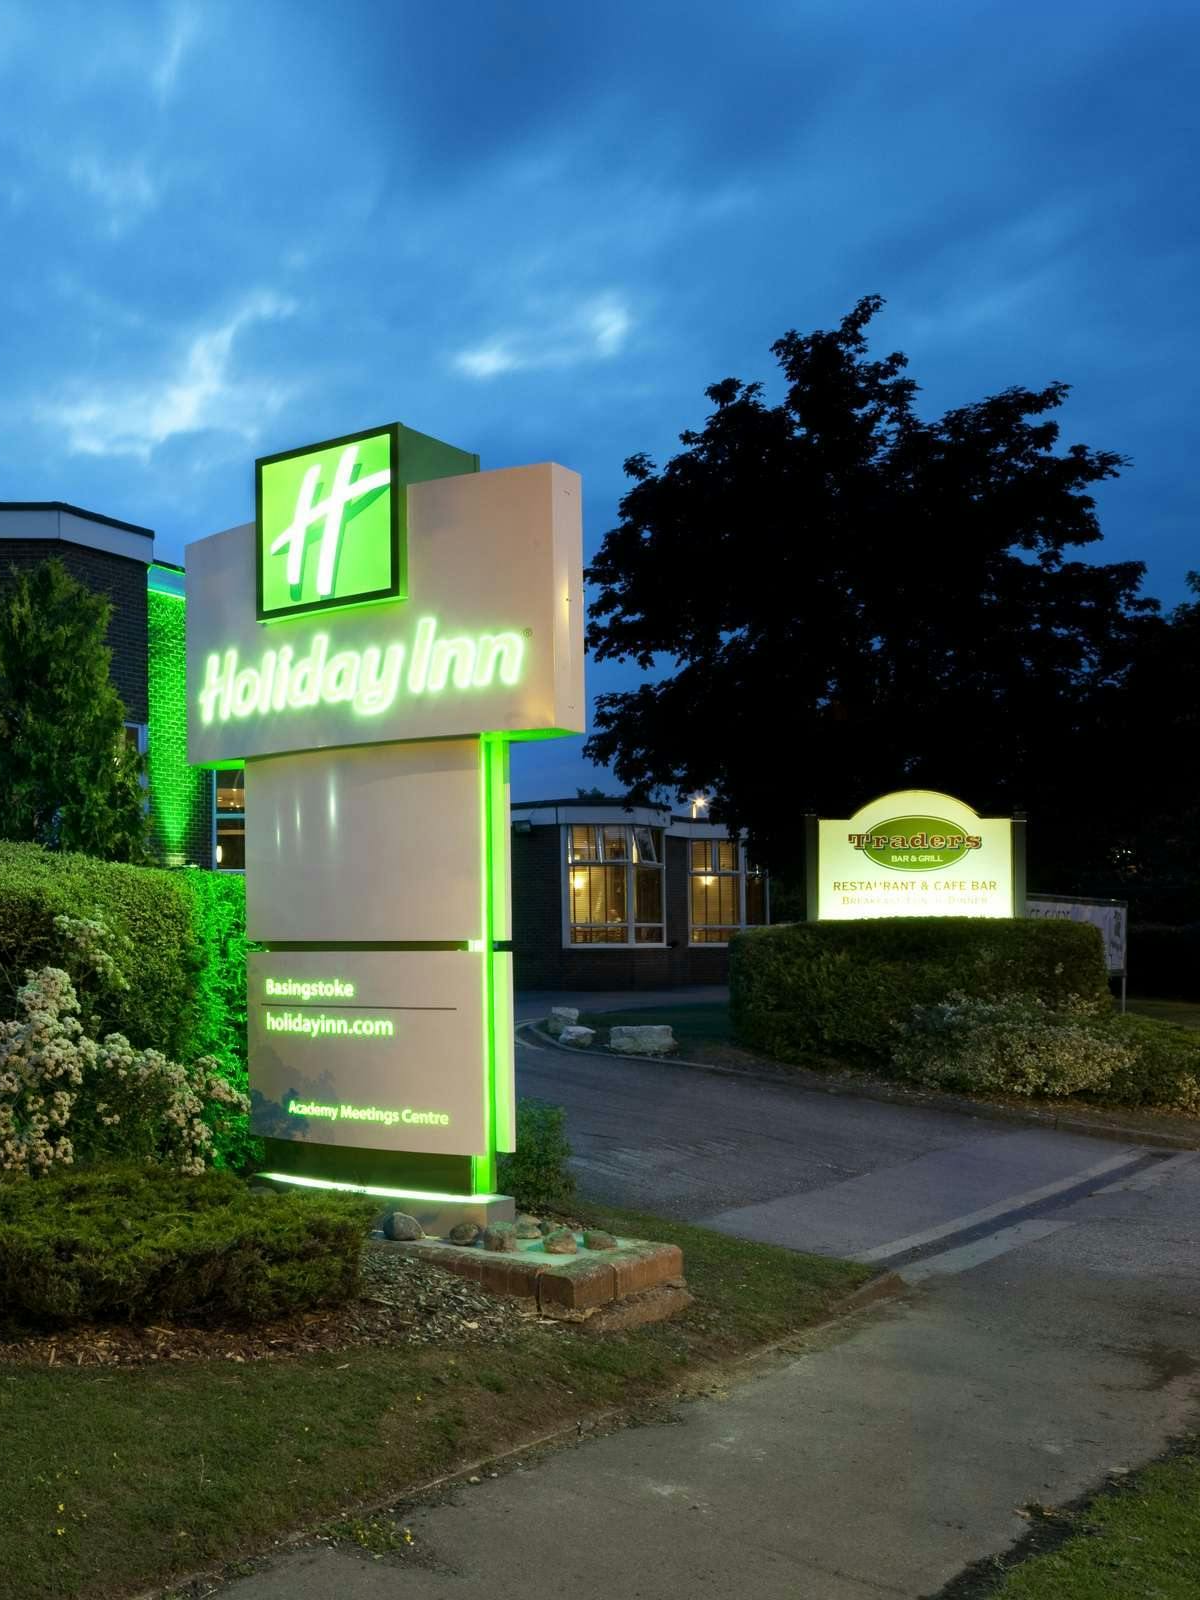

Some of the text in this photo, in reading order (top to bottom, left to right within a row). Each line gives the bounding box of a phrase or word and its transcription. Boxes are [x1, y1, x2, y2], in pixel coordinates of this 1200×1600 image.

[200, 619, 525, 721] Holiday Inn
[848, 833, 982, 850] Traders
[890, 855, 944, 863] BAR & GRILL
[920, 881, 929, 891] &
[933, 881, 967, 891] CAFE
[971, 881, 998, 891] BAR
[265, 979, 354, 1000] Basingstoke
[266, 1013, 394, 1037] holidayinn.com
[288, 1100, 449, 1125] Academy Meetings Centre
